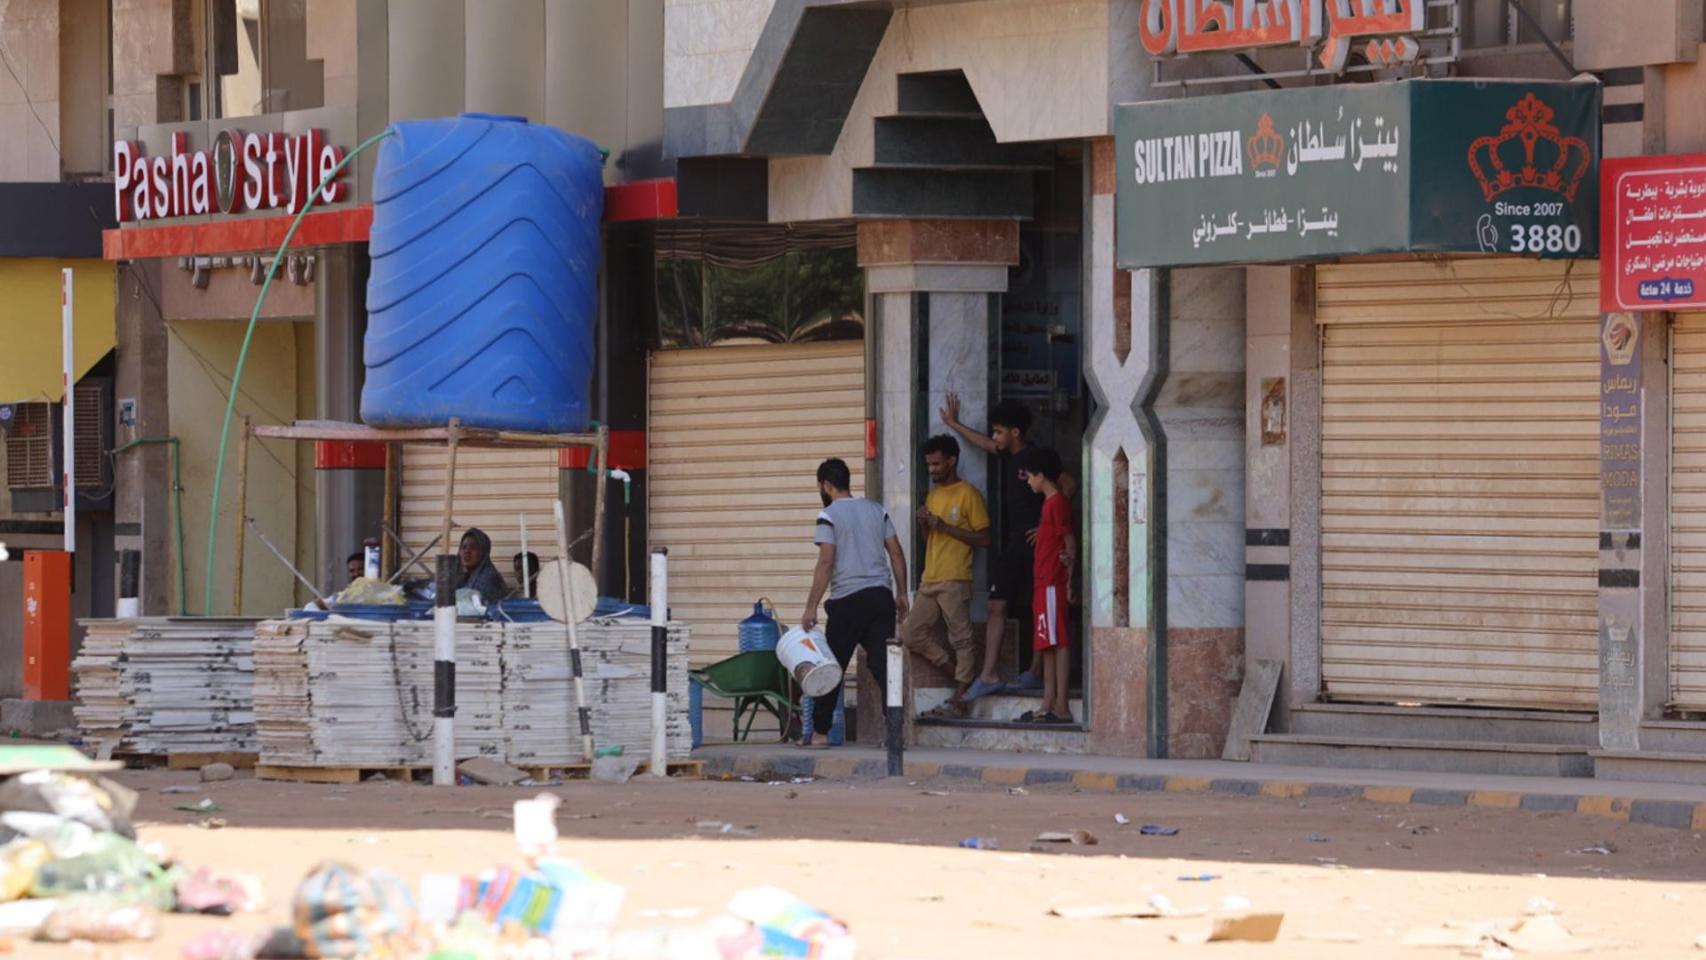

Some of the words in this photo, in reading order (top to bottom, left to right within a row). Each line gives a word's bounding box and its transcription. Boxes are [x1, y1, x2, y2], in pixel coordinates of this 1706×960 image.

[1351, 116, 1399, 174] بيتزا
[1134, 134, 1196, 185] SULTAN
[1199, 130, 1243, 178] PIZZA
[114, 131, 210, 222] Pasha
[243, 128, 337, 215] Style
[1665, 179, 1688, 199] بشرية
[1495, 202, 1530, 216] Since
[1533, 202, 1564, 216] 2007
[1509, 224, 1581, 253] 3880
[1640, 283, 1659, 296] ساعة
[1660, 282, 1671, 295] 24
[1674, 282, 1692, 294] خدمة
[1603, 402, 1637, 423] مودا
[1603, 443, 1640, 460] RIMAS
[1602, 471, 1638, 488] MODA
